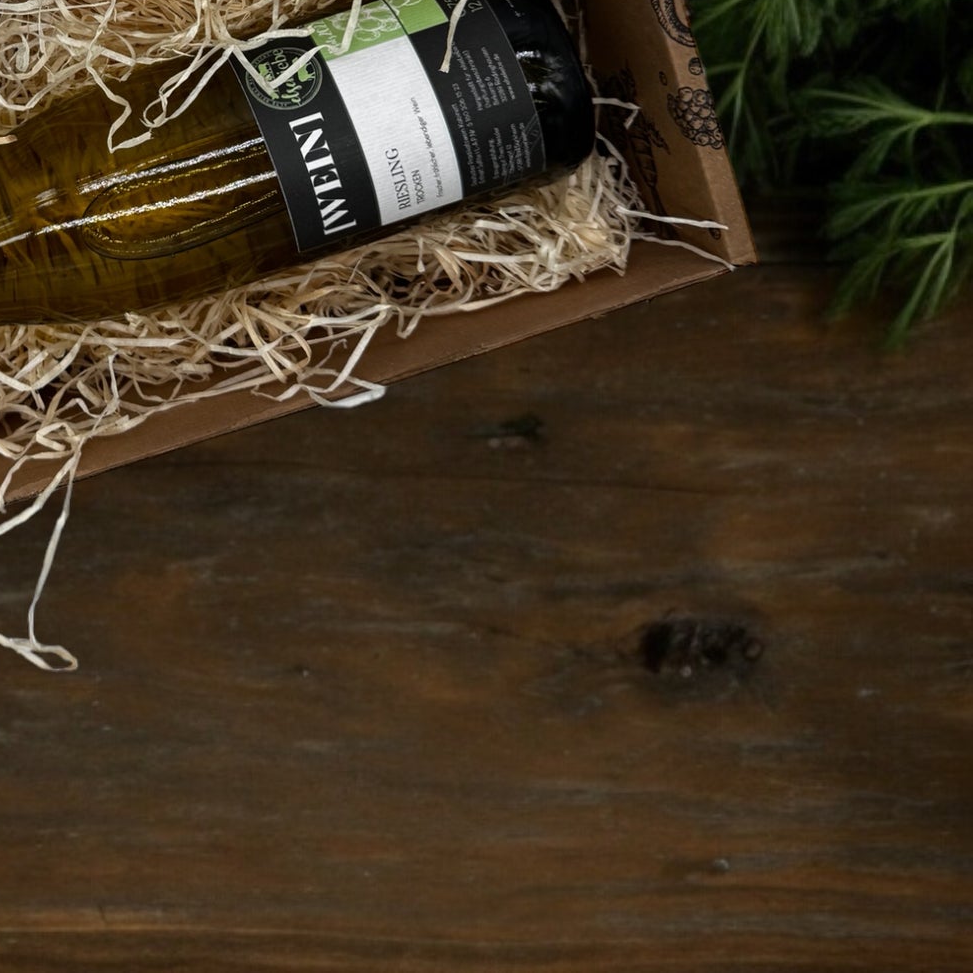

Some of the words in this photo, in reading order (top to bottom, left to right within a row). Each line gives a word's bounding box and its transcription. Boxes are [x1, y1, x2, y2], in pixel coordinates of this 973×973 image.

[272, 48, 302, 106] elseiebe
[288, 111, 357, 235] [WEIN]
[385, 148, 411, 210] RIESLING
[411, 170, 425, 204] TROCKEN
